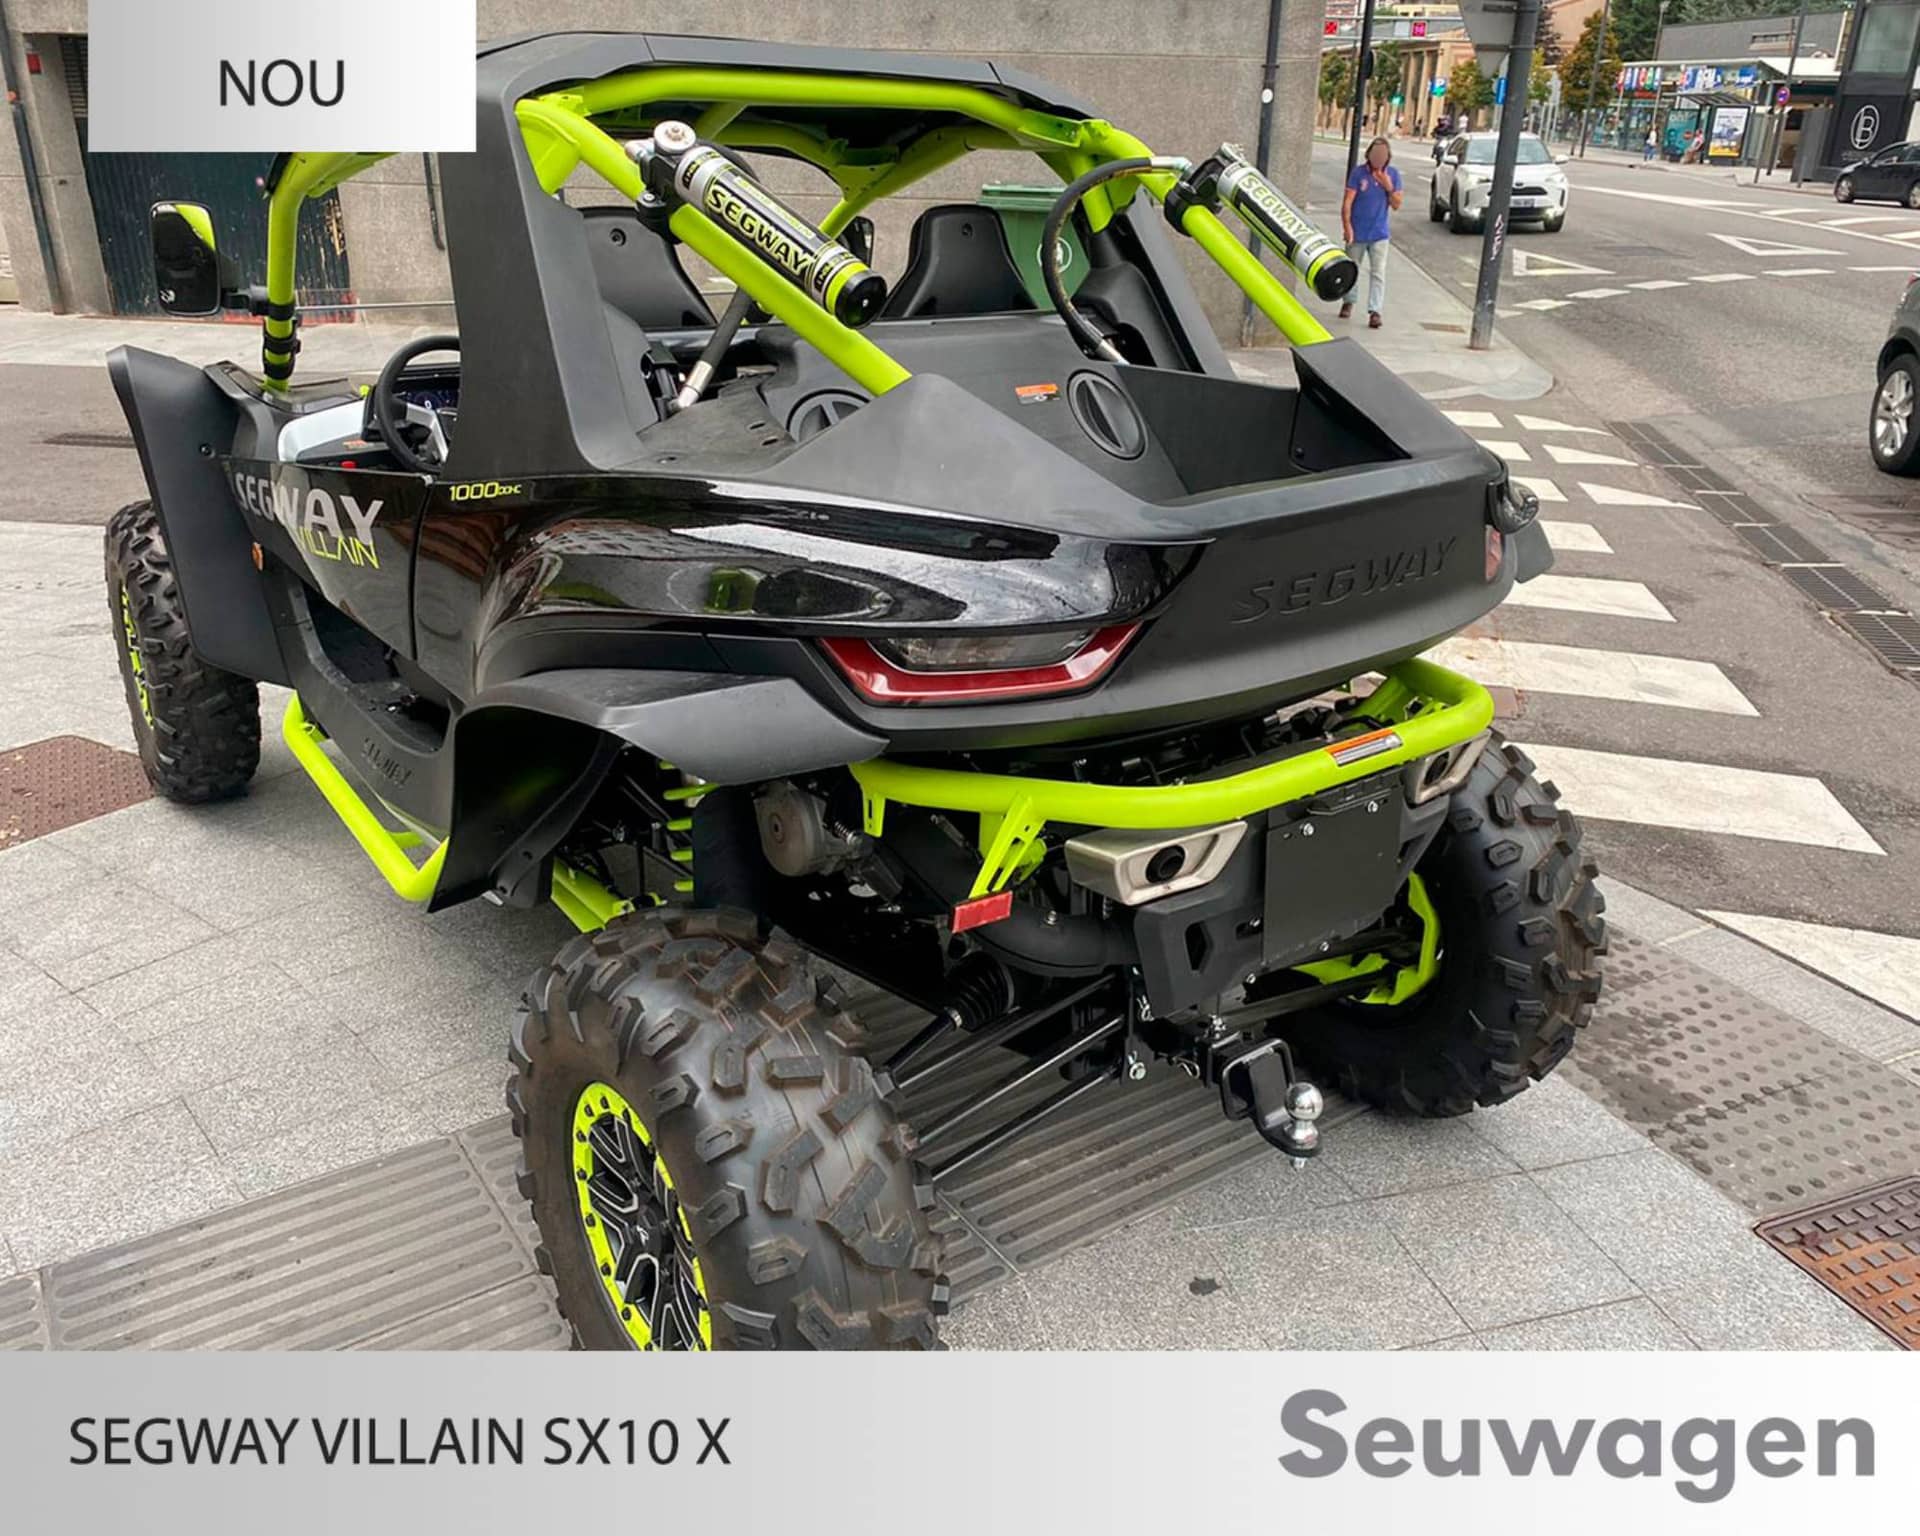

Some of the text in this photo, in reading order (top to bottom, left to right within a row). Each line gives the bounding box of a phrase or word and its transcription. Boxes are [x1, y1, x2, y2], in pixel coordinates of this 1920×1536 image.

[704, 181, 818, 277] SEGWAY
[1239, 174, 1312, 240] SEGWAY
[234, 471, 384, 546] SEGWAY
[449, 482, 500, 502] 1000
[299, 526, 380, 569] VILLAIN
[1230, 536, 1457, 624] SEGWAY
